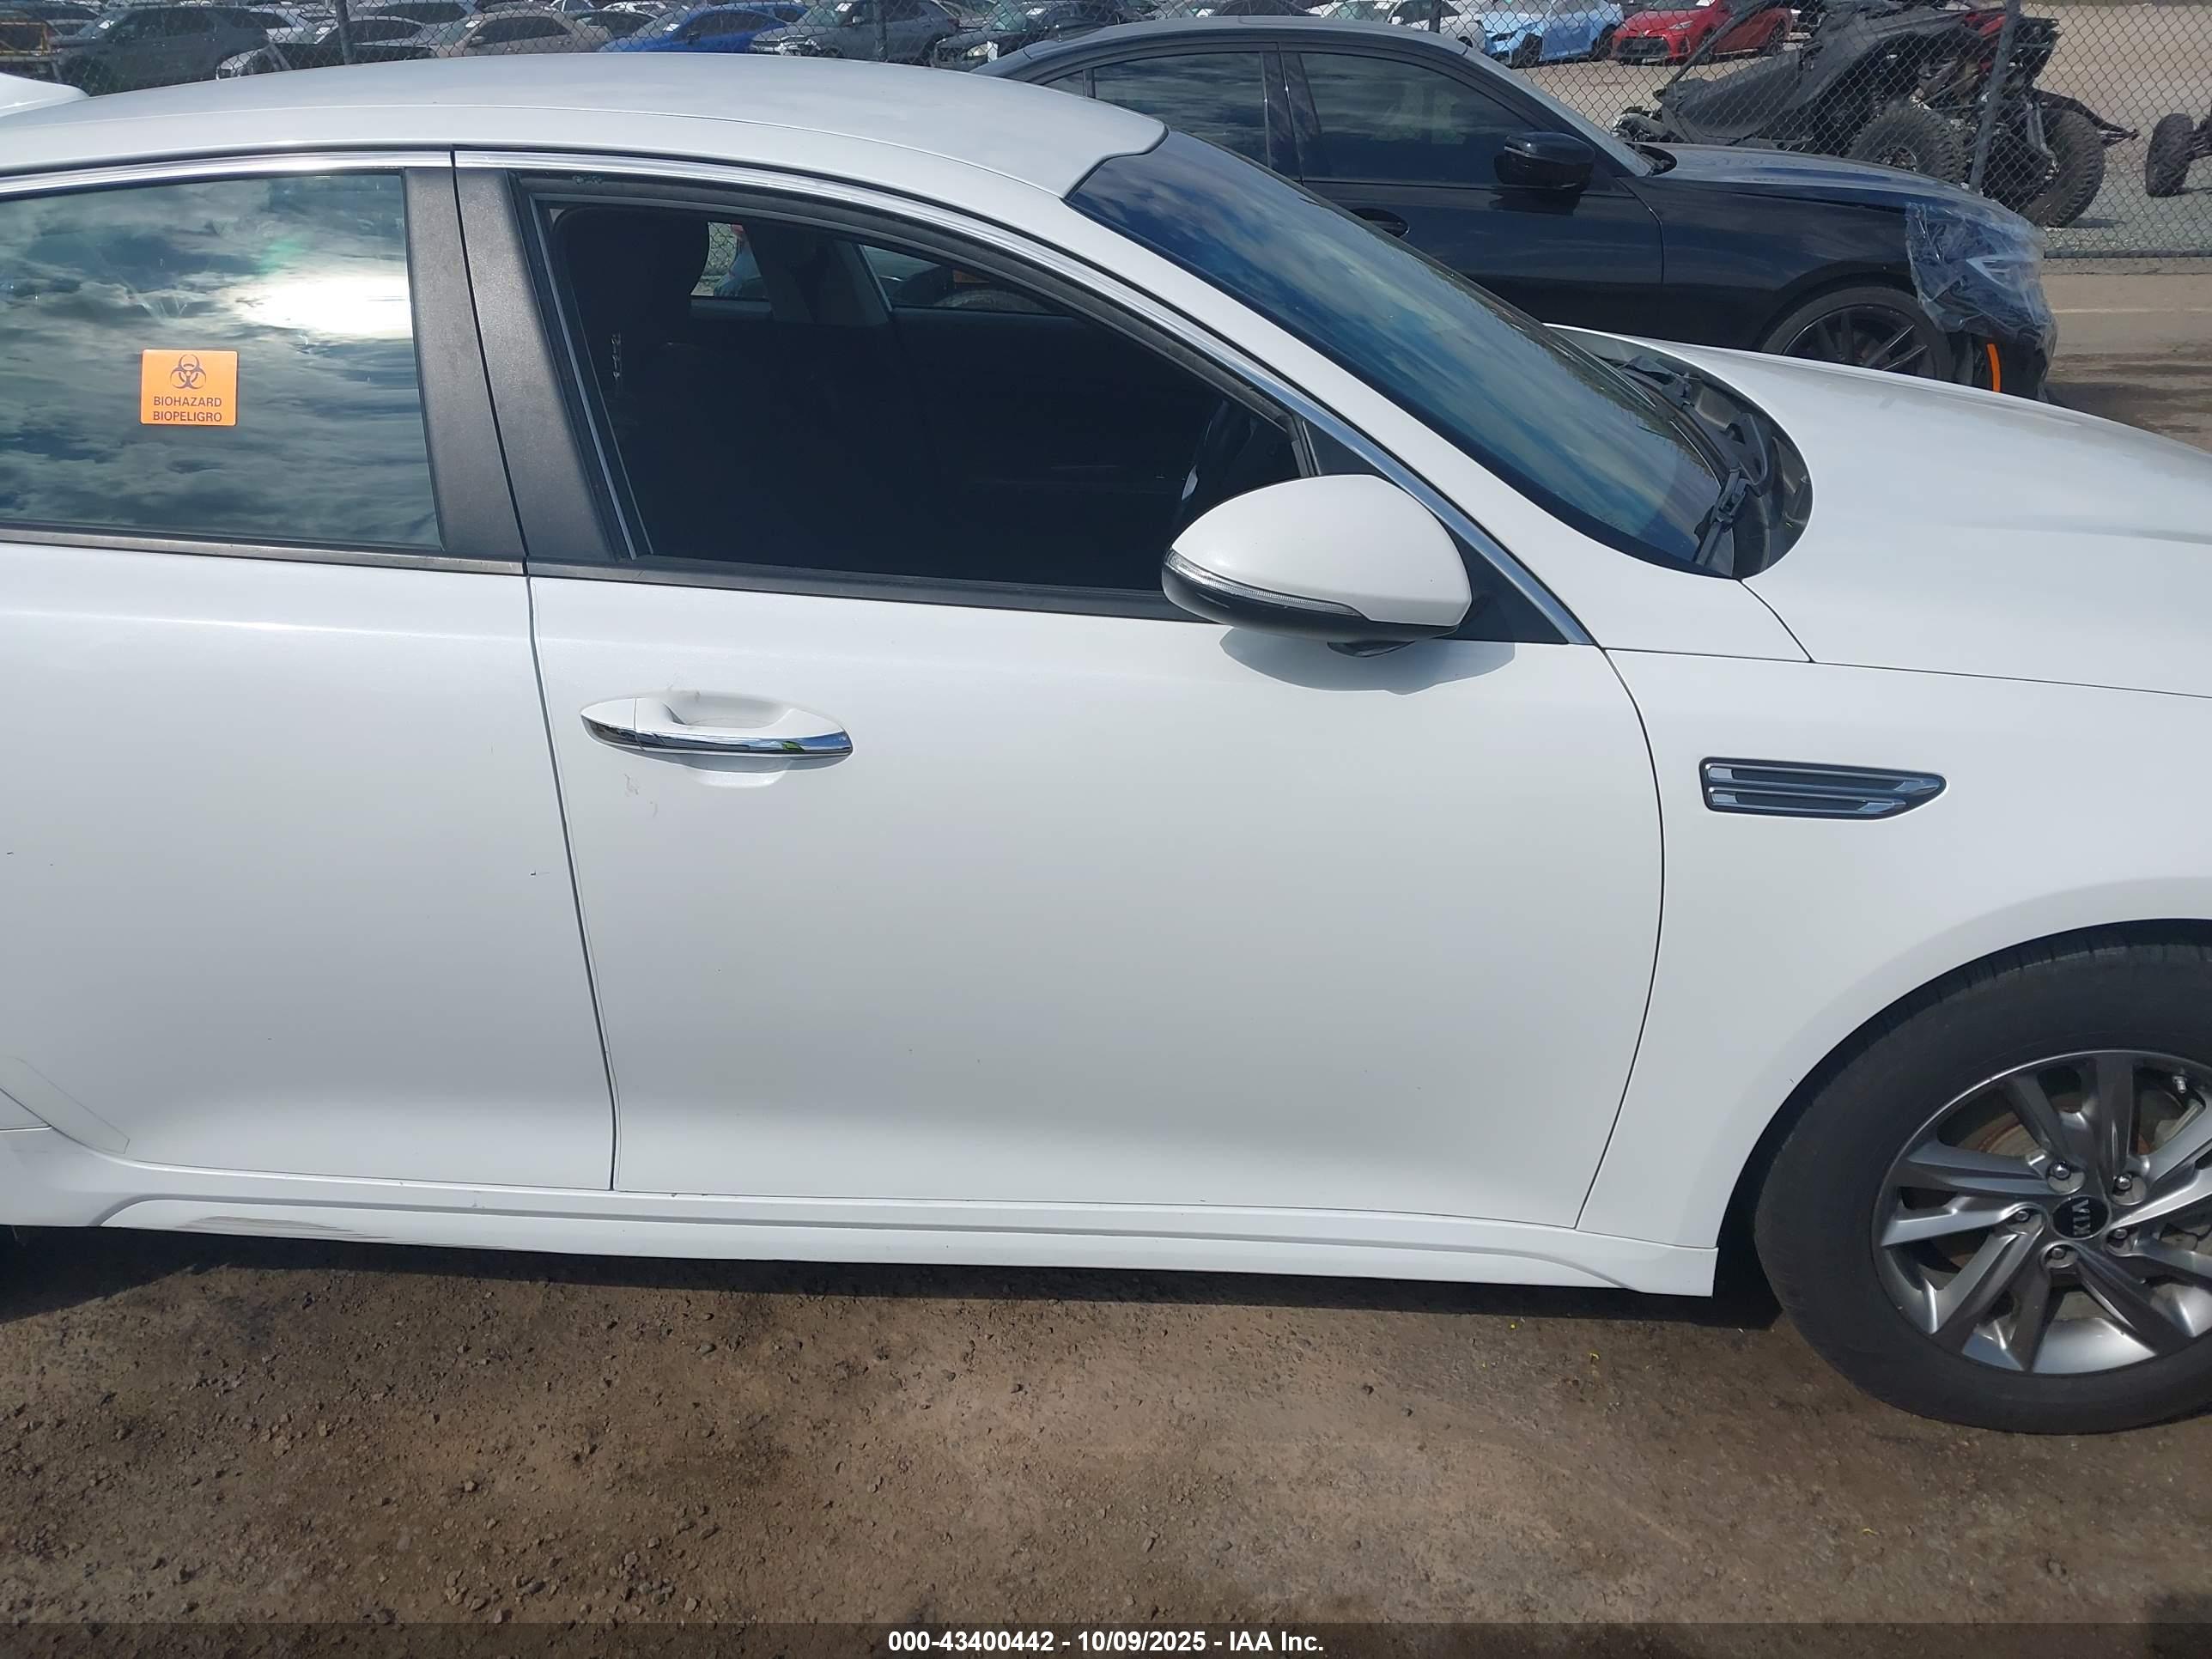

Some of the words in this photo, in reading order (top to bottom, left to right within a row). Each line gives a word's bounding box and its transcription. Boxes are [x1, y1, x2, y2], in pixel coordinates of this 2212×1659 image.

[153, 396, 222, 407] BIOHAZARD
[153, 411, 222, 422] BIOPELIGRO
[2071, 1199, 2091, 1236] KIA
